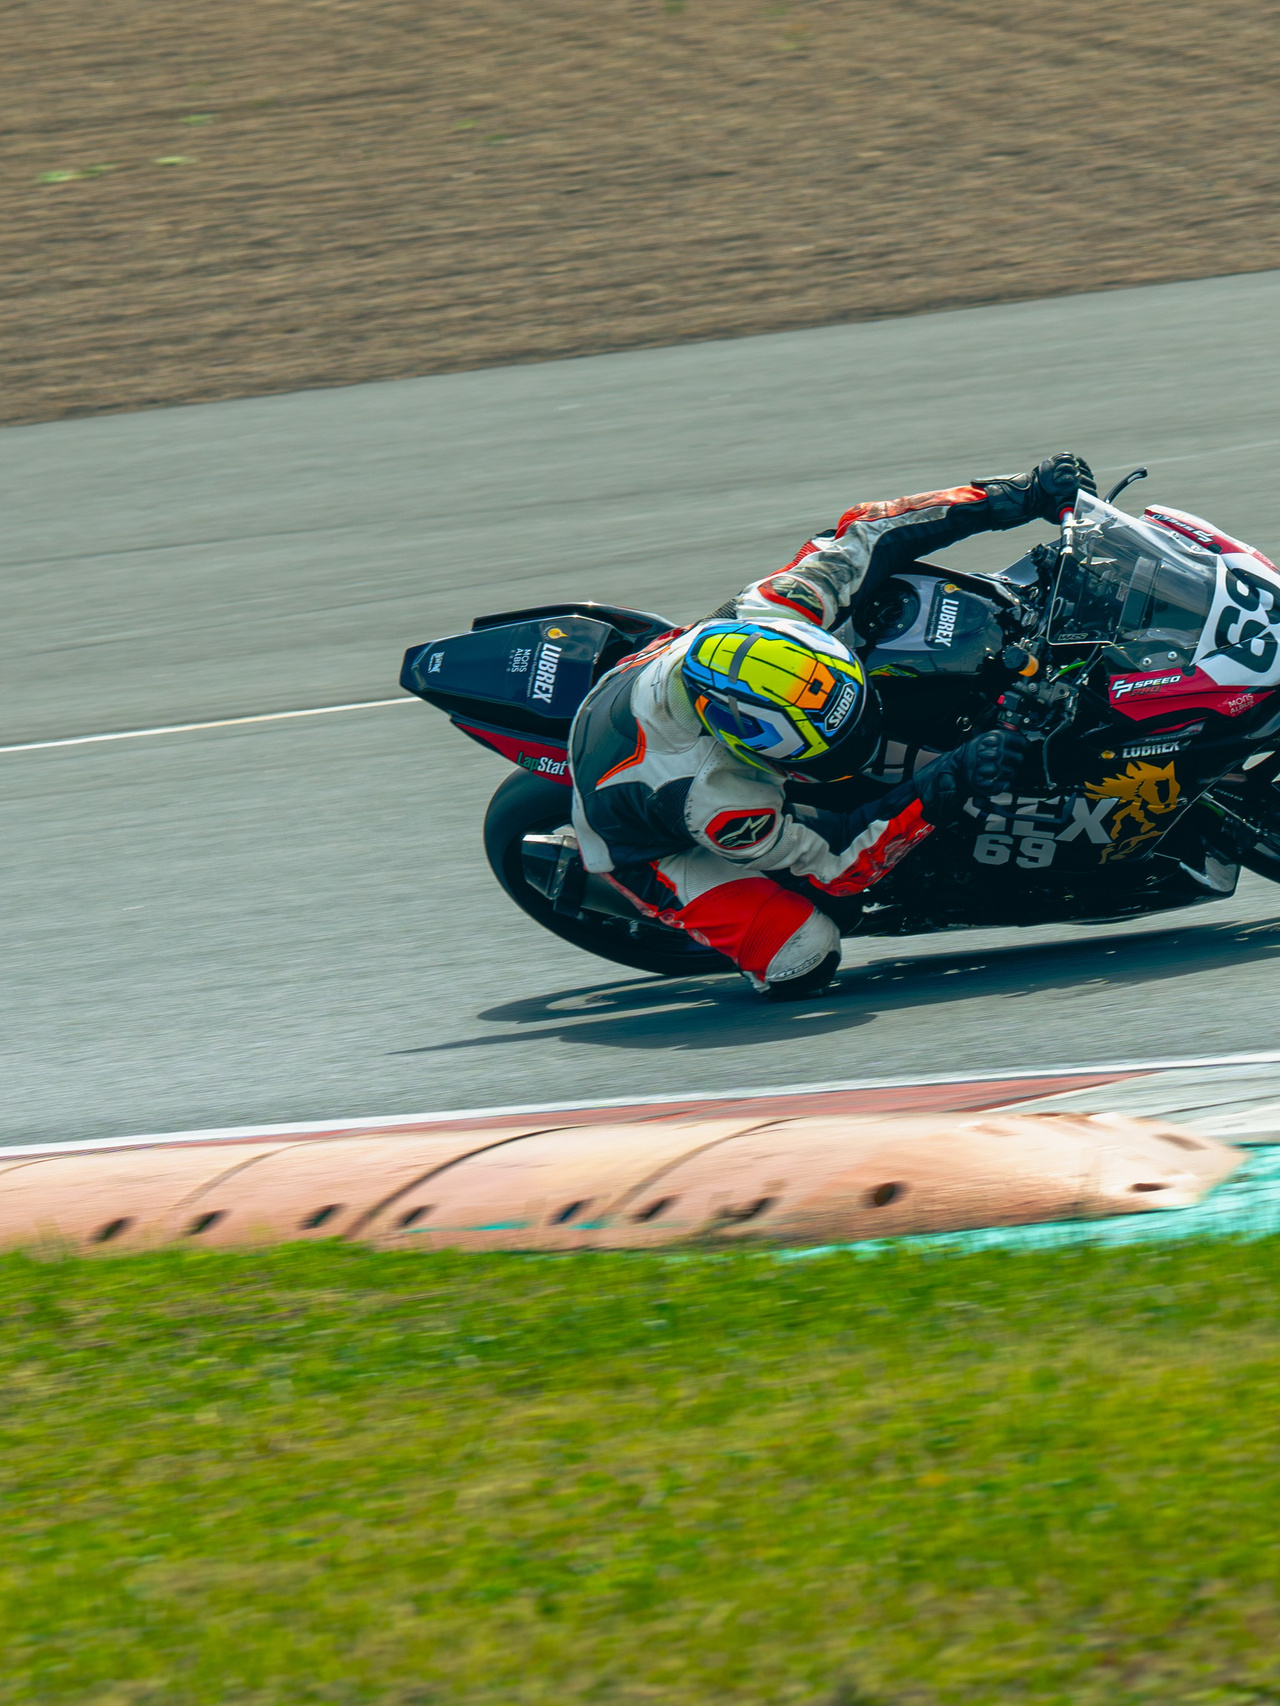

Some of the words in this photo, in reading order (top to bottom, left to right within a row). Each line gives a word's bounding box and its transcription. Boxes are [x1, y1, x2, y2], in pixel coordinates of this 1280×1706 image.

[934, 598, 959, 647] LUBREX
[532, 643, 562, 704] LUBREX
[1134, 675, 1181, 690] SPEED
[828, 689, 855, 728] SHOEI
[517, 751, 568, 776] LapStat
[1122, 741, 1180, 759] LUBREX
[973, 833, 1057, 869] 69
